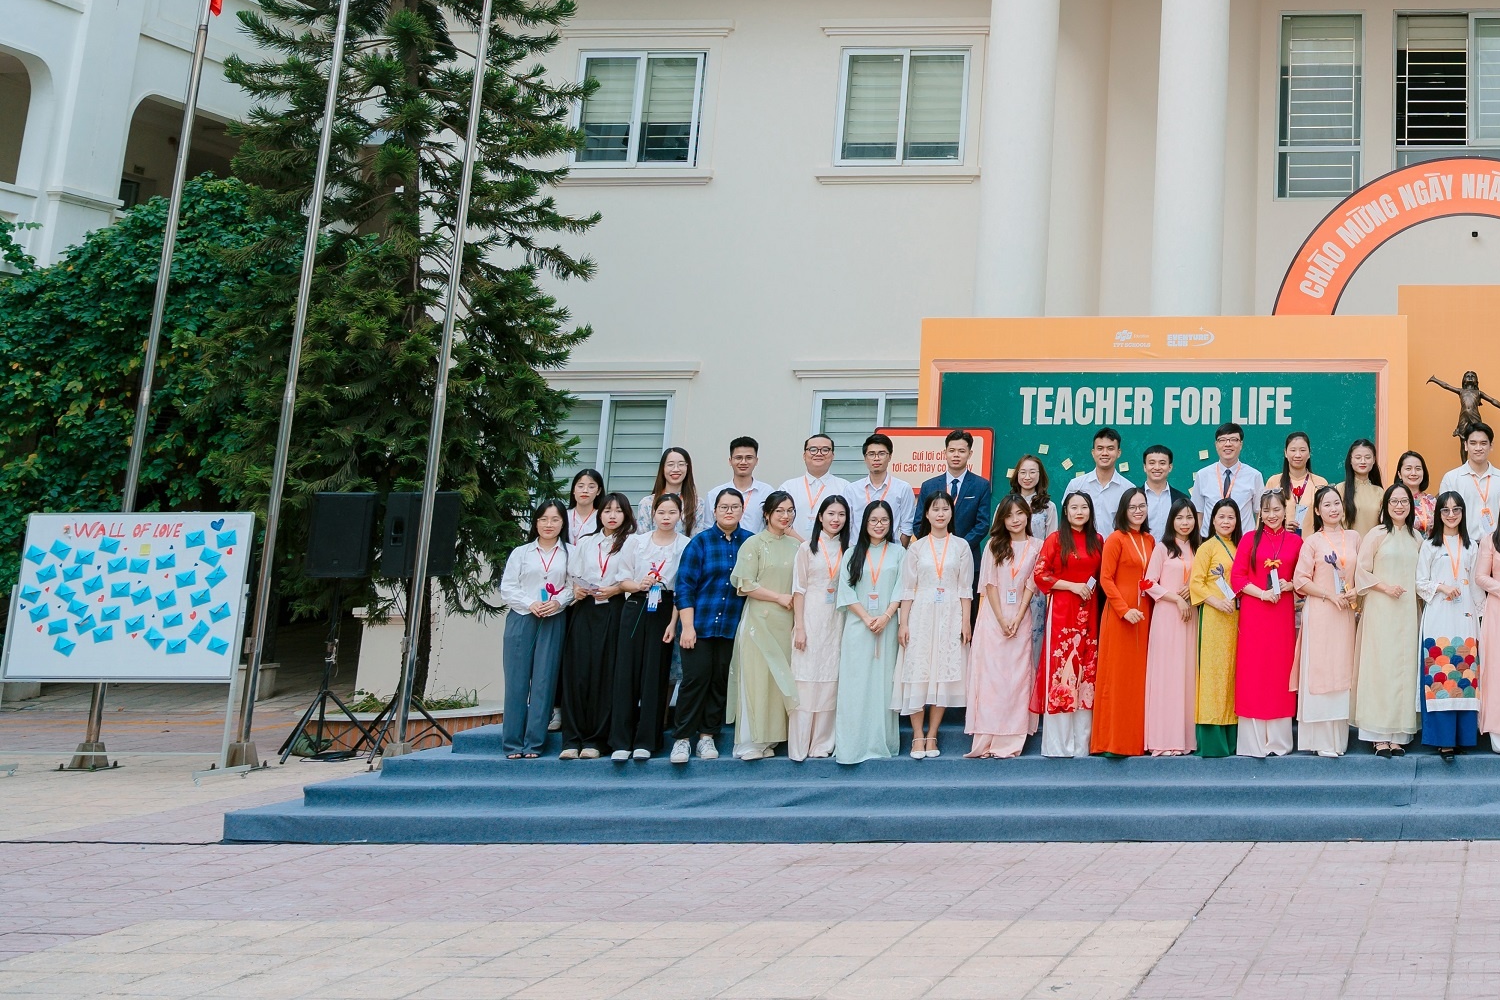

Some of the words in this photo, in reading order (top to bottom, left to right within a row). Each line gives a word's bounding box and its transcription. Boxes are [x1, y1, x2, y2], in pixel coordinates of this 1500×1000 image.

[1019, 386, 1154, 426] TEACHER
[1163, 386, 1221, 426] FOR
[1232, 386, 1292, 426] LIFE
[74, 521, 126, 539] WALL
[132, 522, 151, 538] OF
[153, 522, 183, 538] LOVE
